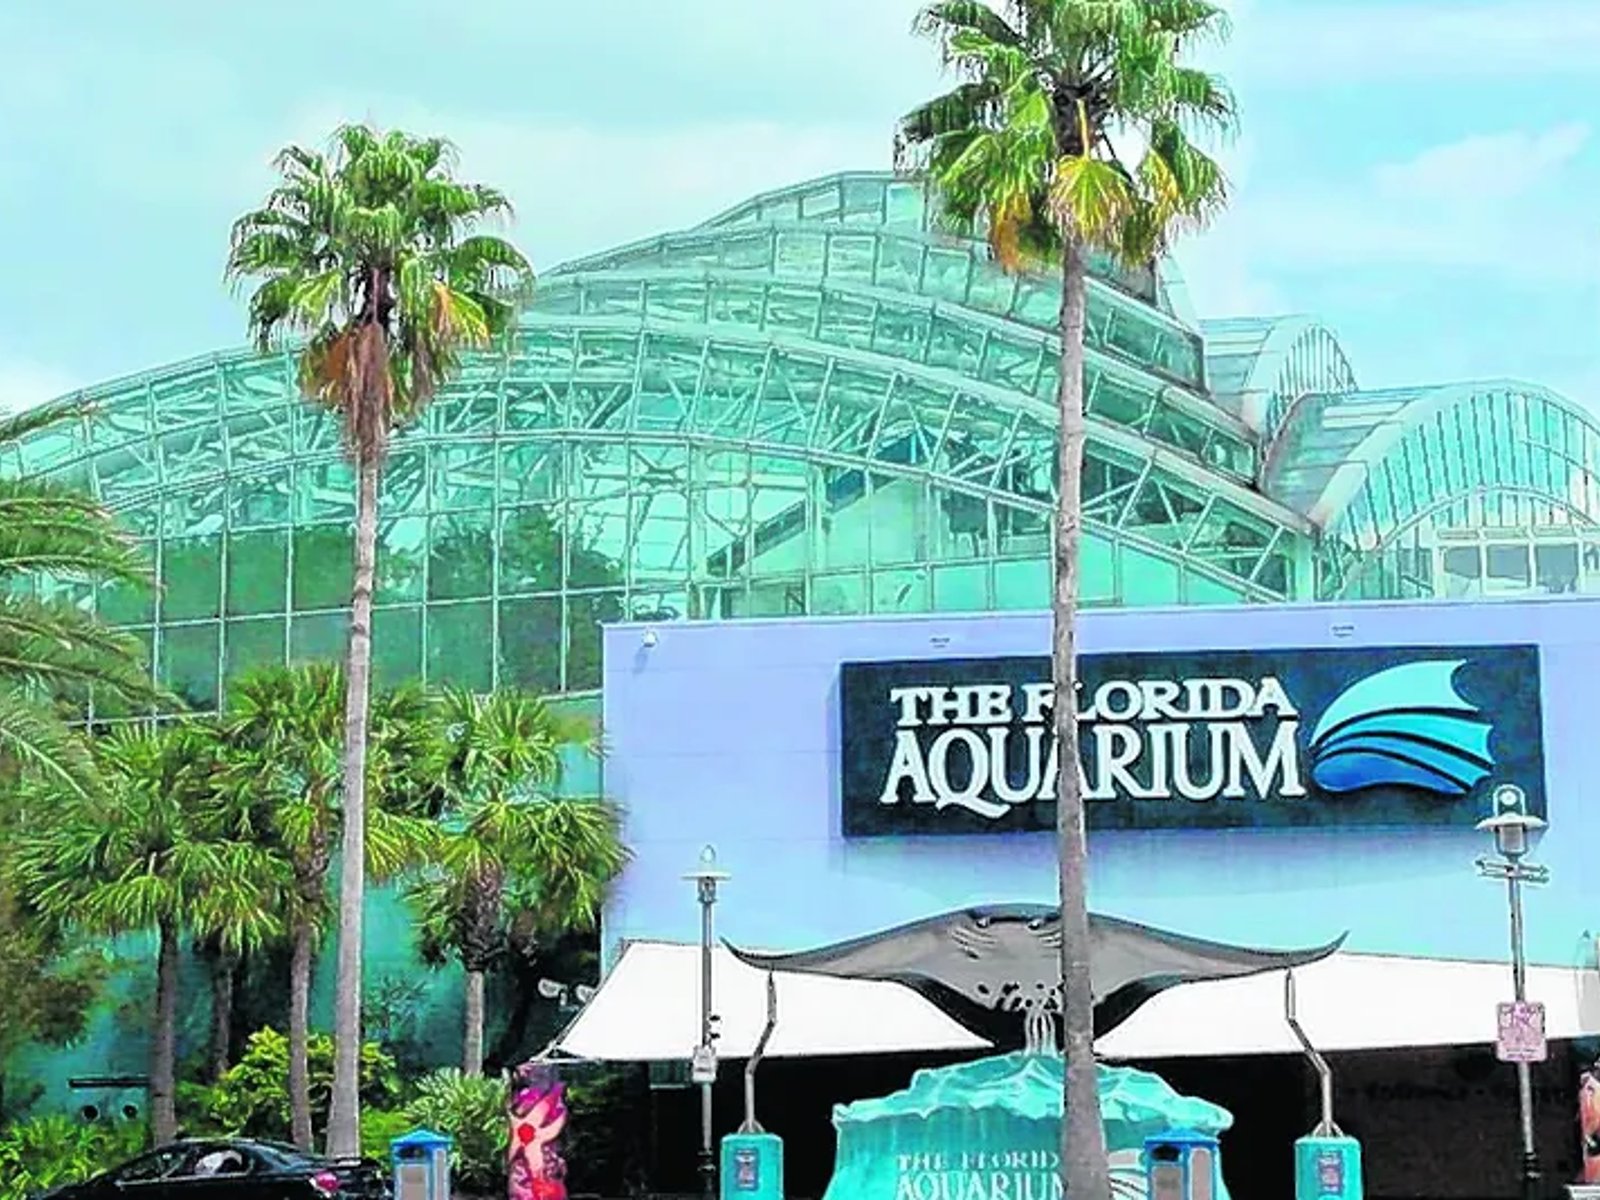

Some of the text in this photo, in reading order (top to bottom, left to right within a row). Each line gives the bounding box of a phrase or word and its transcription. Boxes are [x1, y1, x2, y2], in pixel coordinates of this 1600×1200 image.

[890, 685, 1012, 726] THE
[879, 721, 1306, 818] AQUARIUM
[897, 1149, 1061, 1171] THE FLORID
